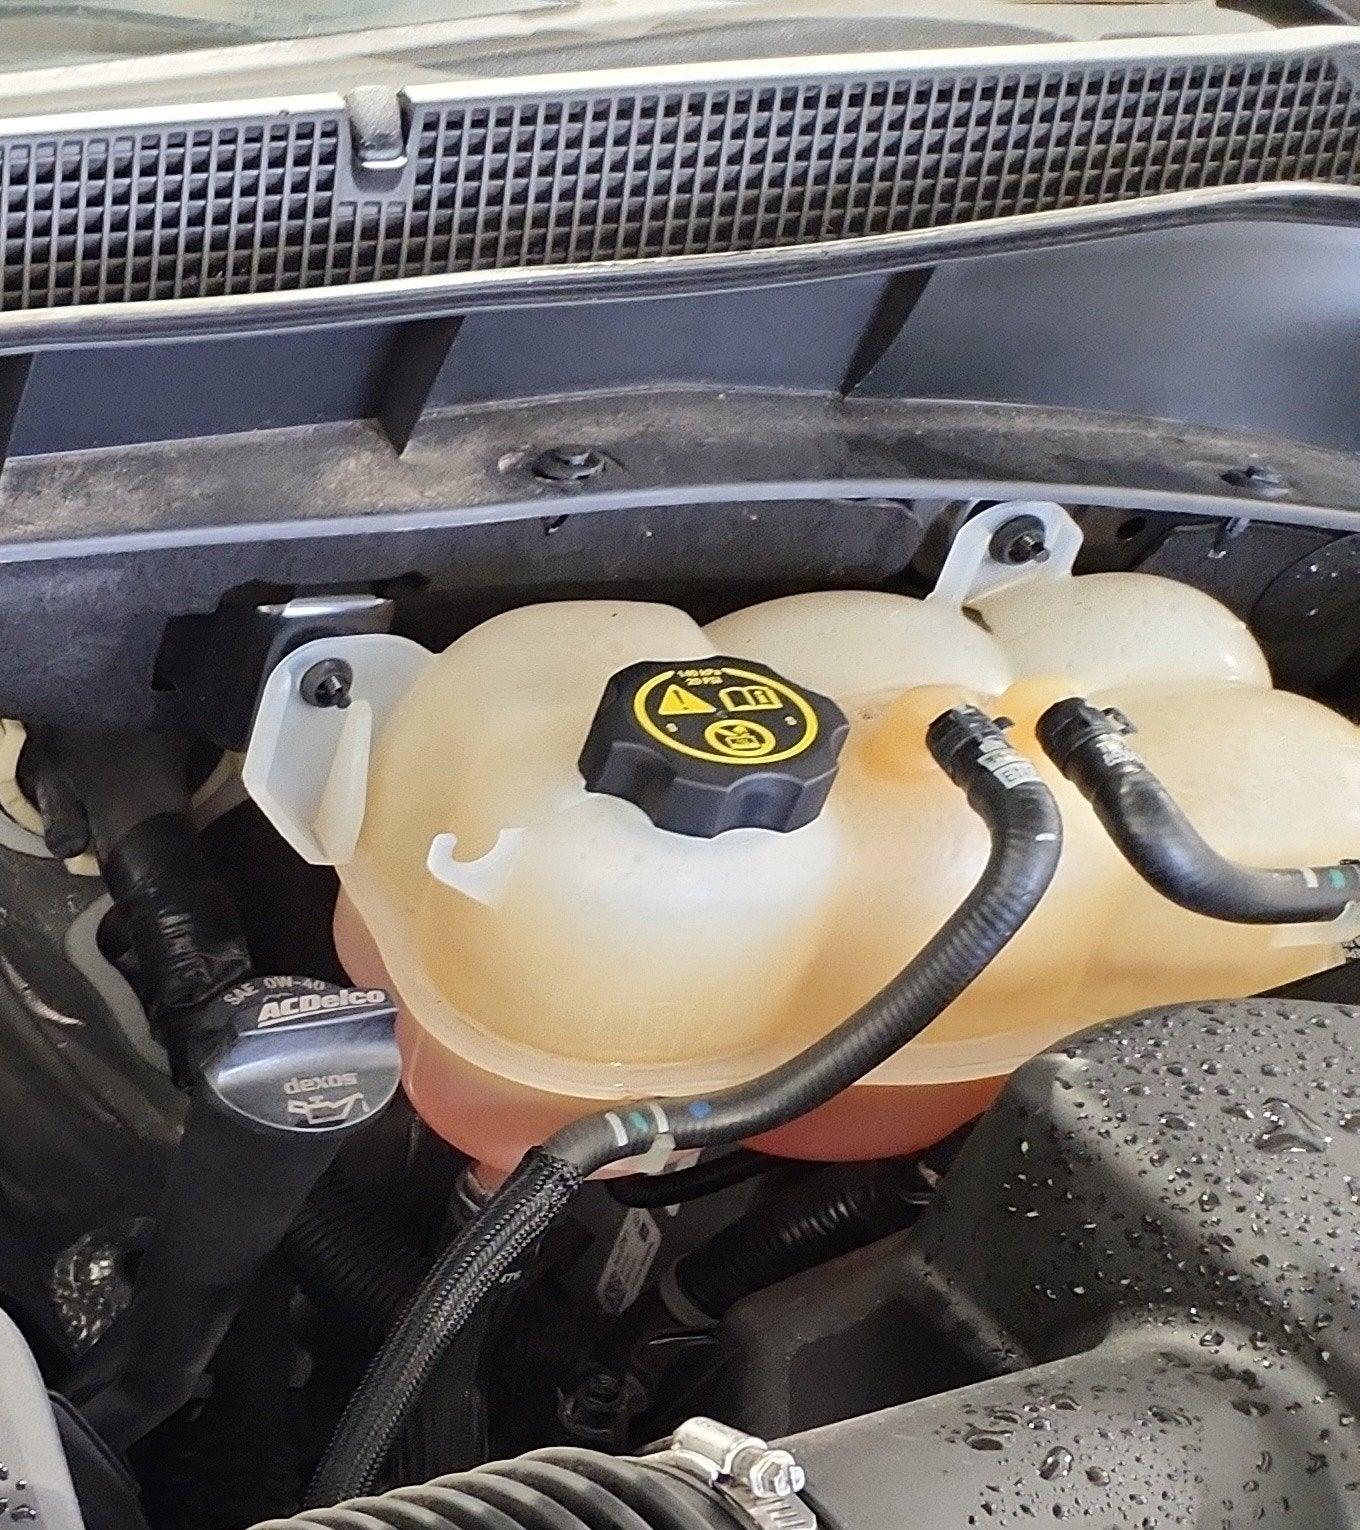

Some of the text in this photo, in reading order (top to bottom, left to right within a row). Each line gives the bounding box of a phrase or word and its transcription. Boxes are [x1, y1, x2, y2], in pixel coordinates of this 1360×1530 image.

[223, 975, 326, 1006] SAE 0W-40
[258, 989, 386, 1023] ACDelco
[283, 1072, 359, 1095] dexos
